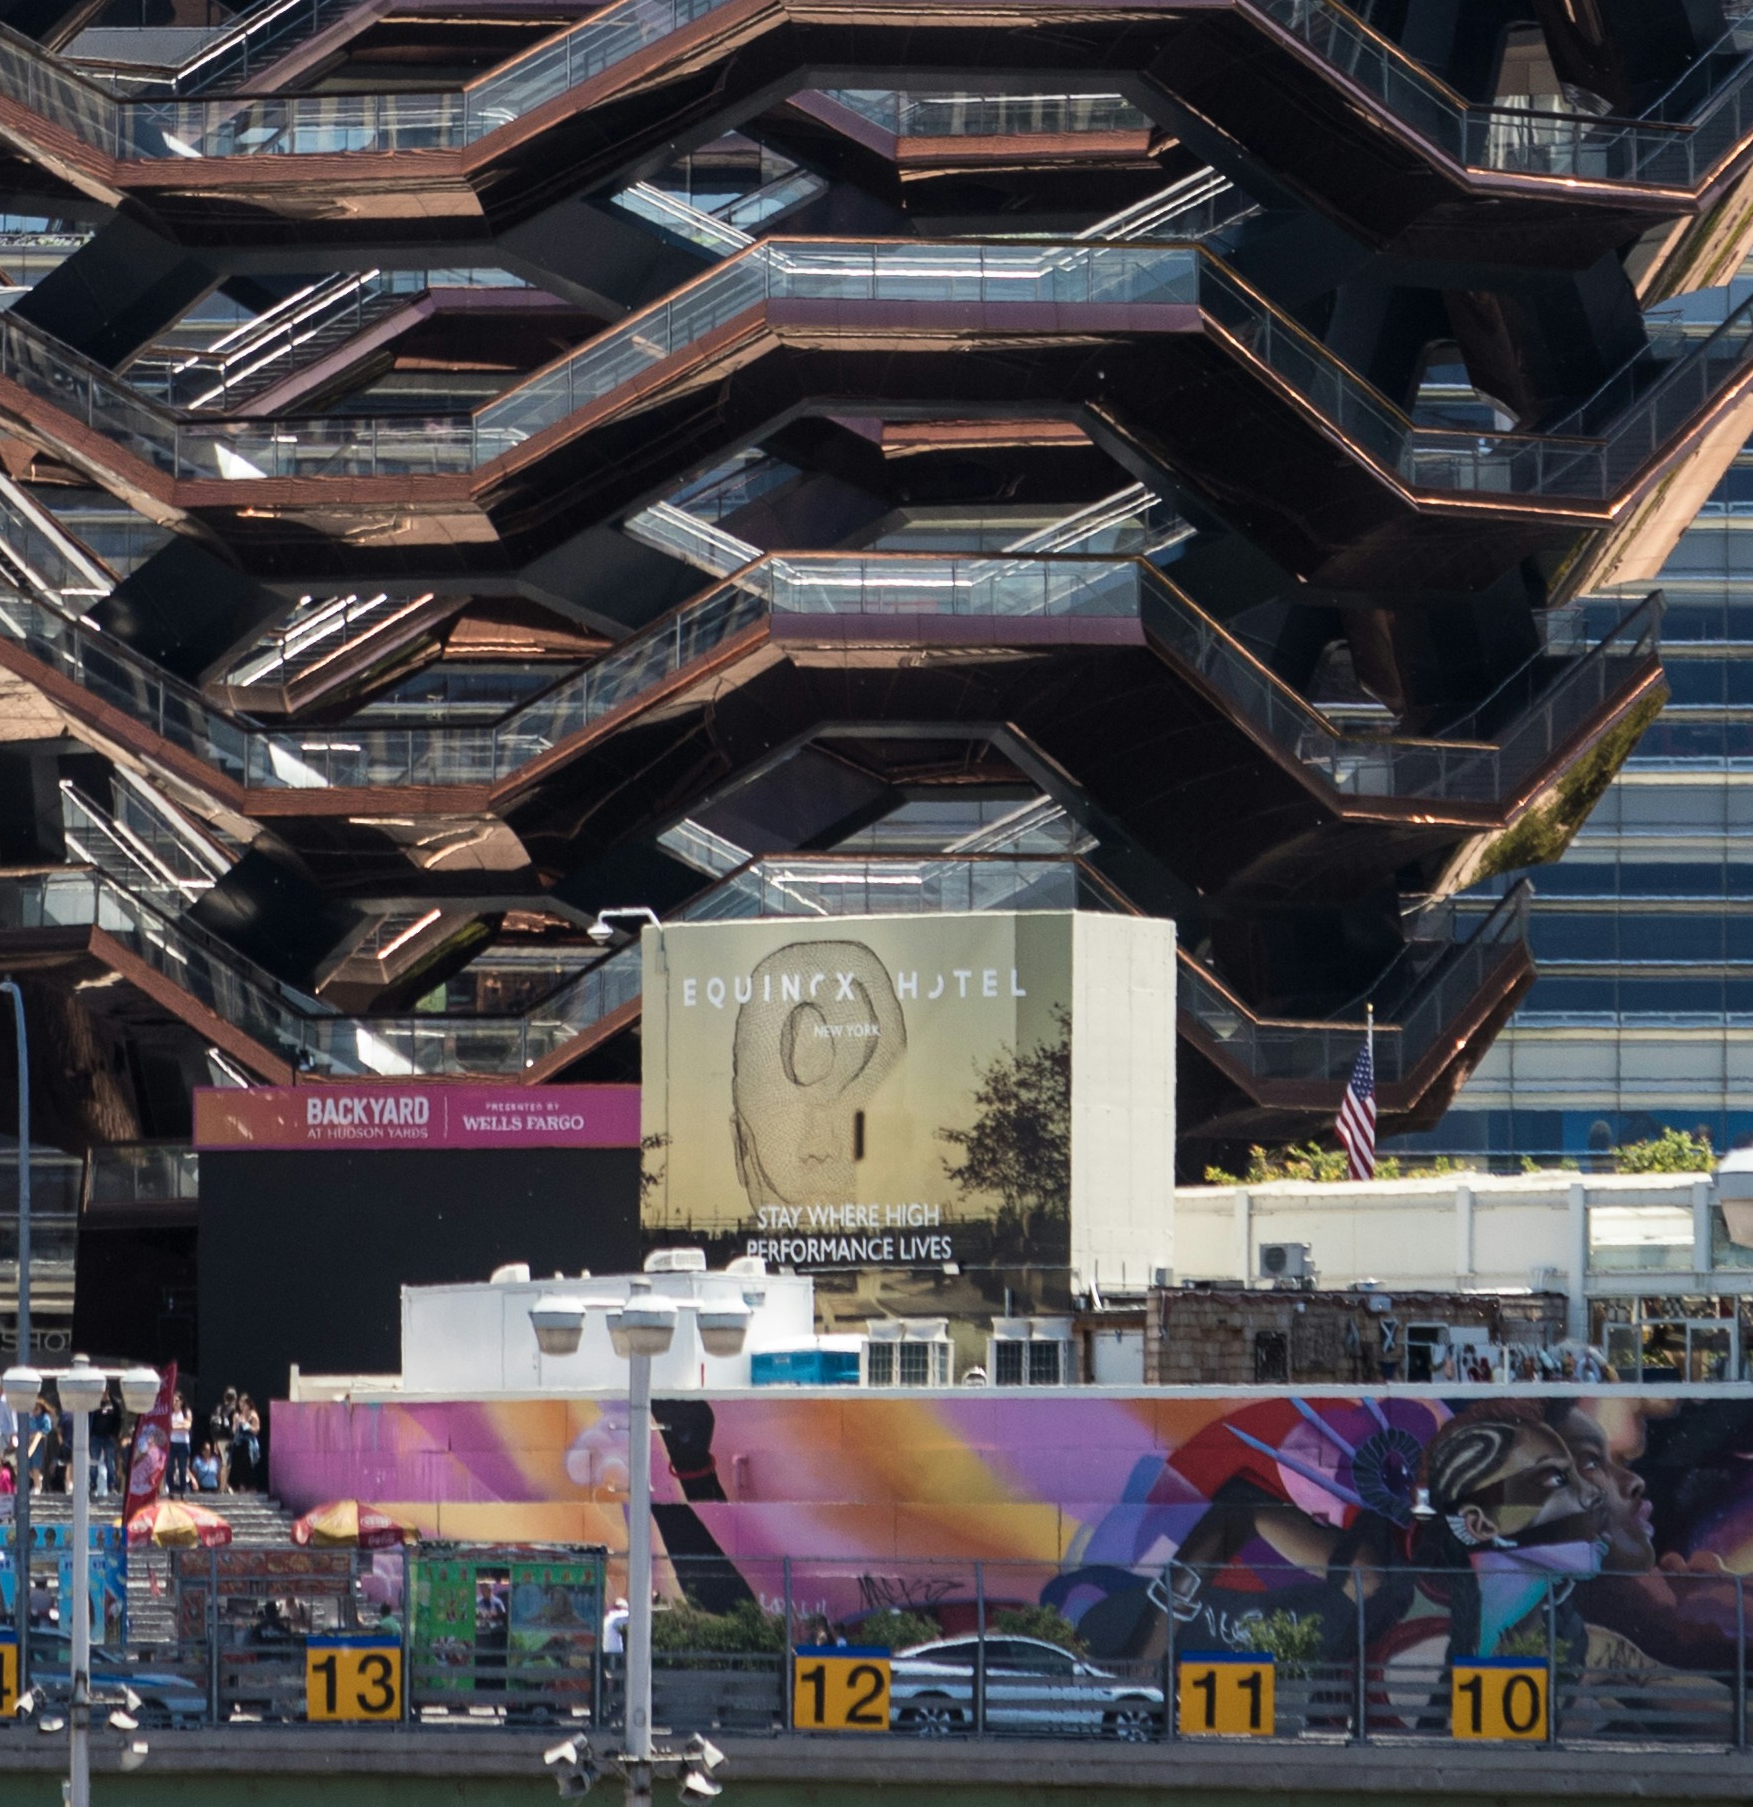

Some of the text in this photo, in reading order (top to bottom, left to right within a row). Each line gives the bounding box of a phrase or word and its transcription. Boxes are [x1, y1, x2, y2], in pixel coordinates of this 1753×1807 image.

[813, 1023, 882, 1039] NEW YORK
[307, 1096, 430, 1125] BACKYARD
[462, 1115, 585, 1131] WELLS FARGO
[307, 1126, 429, 1140] AT HUDSON YARDS
[757, 1203, 940, 1230] STAY WHERE HIGH
[746, 1234, 952, 1263] PERFORMANCE LIVES
[1, 1330, 72, 1353] SHO
[312, 1654, 395, 1714] 13
[801, 1664, 885, 1724] 12
[1192, 1670, 1262, 1729] 11
[1458, 1674, 1541, 1734] 10
